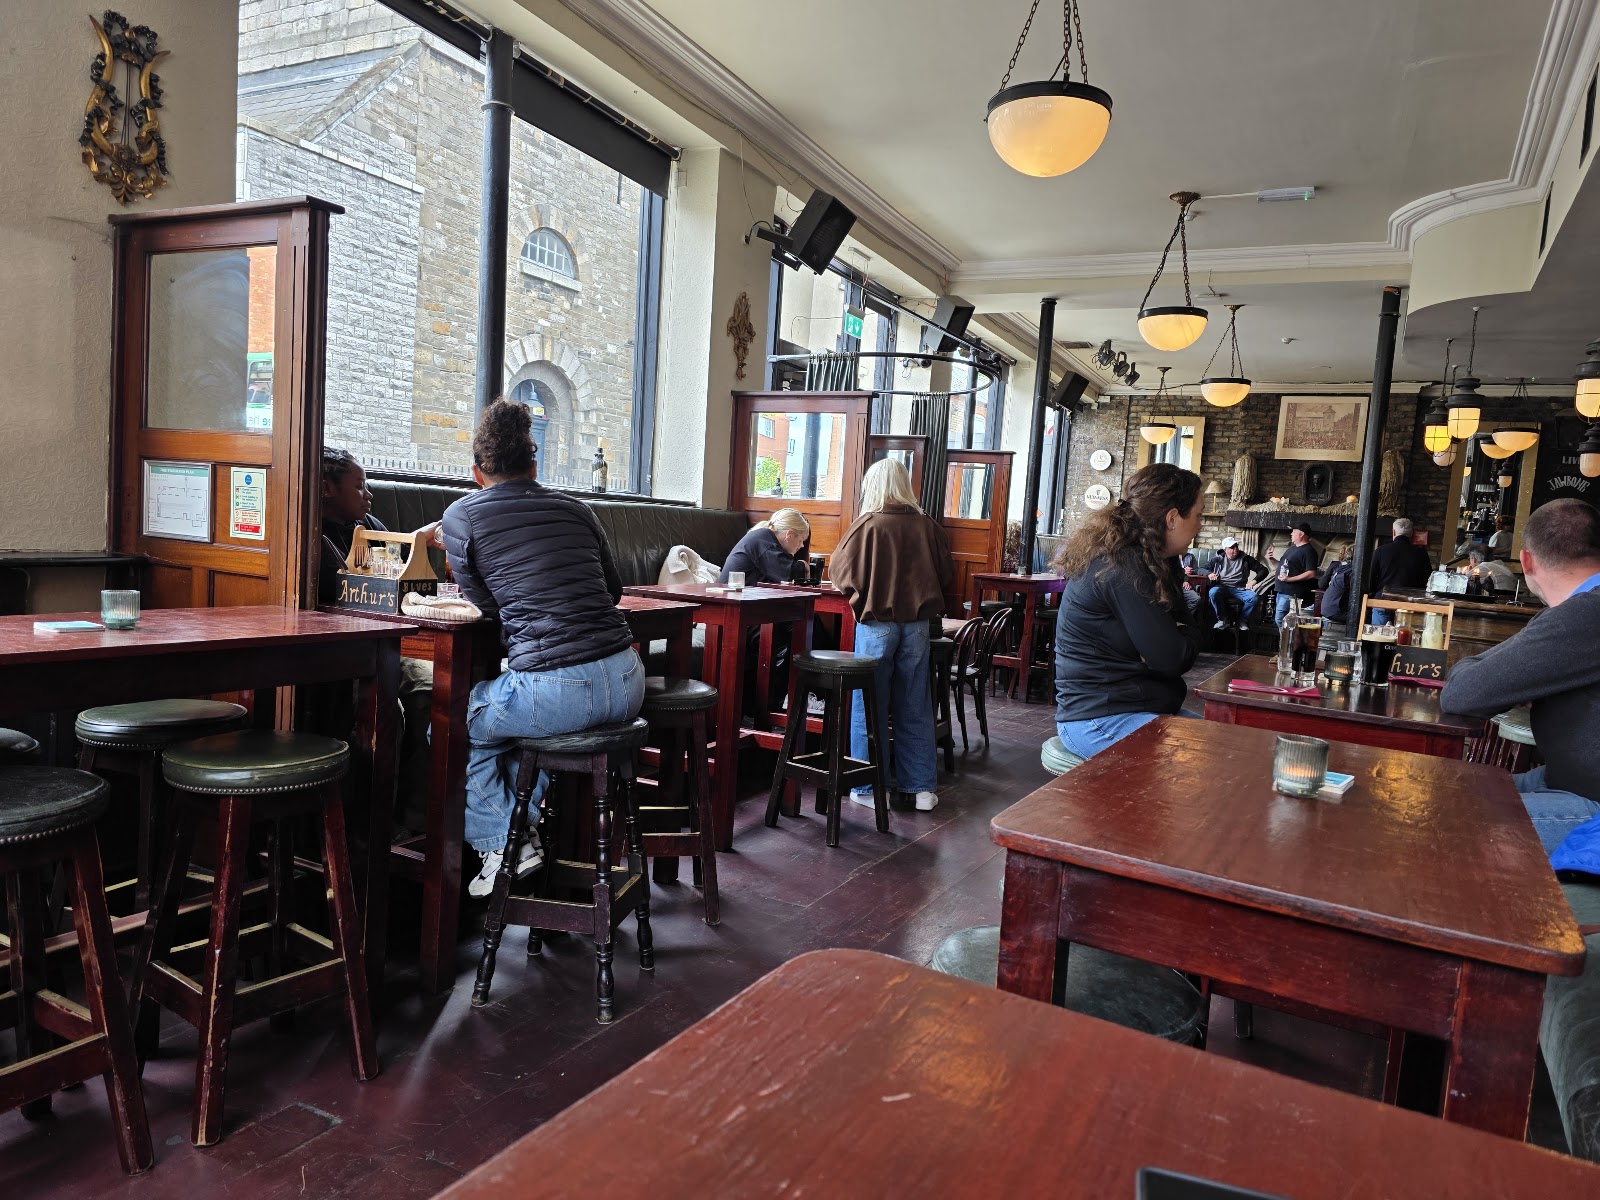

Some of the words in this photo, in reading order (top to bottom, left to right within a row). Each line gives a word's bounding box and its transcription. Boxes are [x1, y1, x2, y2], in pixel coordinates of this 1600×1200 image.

[1562, 456, 1580, 465] LIV
[1547, 476, 1591, 493] JAWBONE
[337, 579, 396, 607] Arthur's
[1390, 653, 1442, 678] hur's
